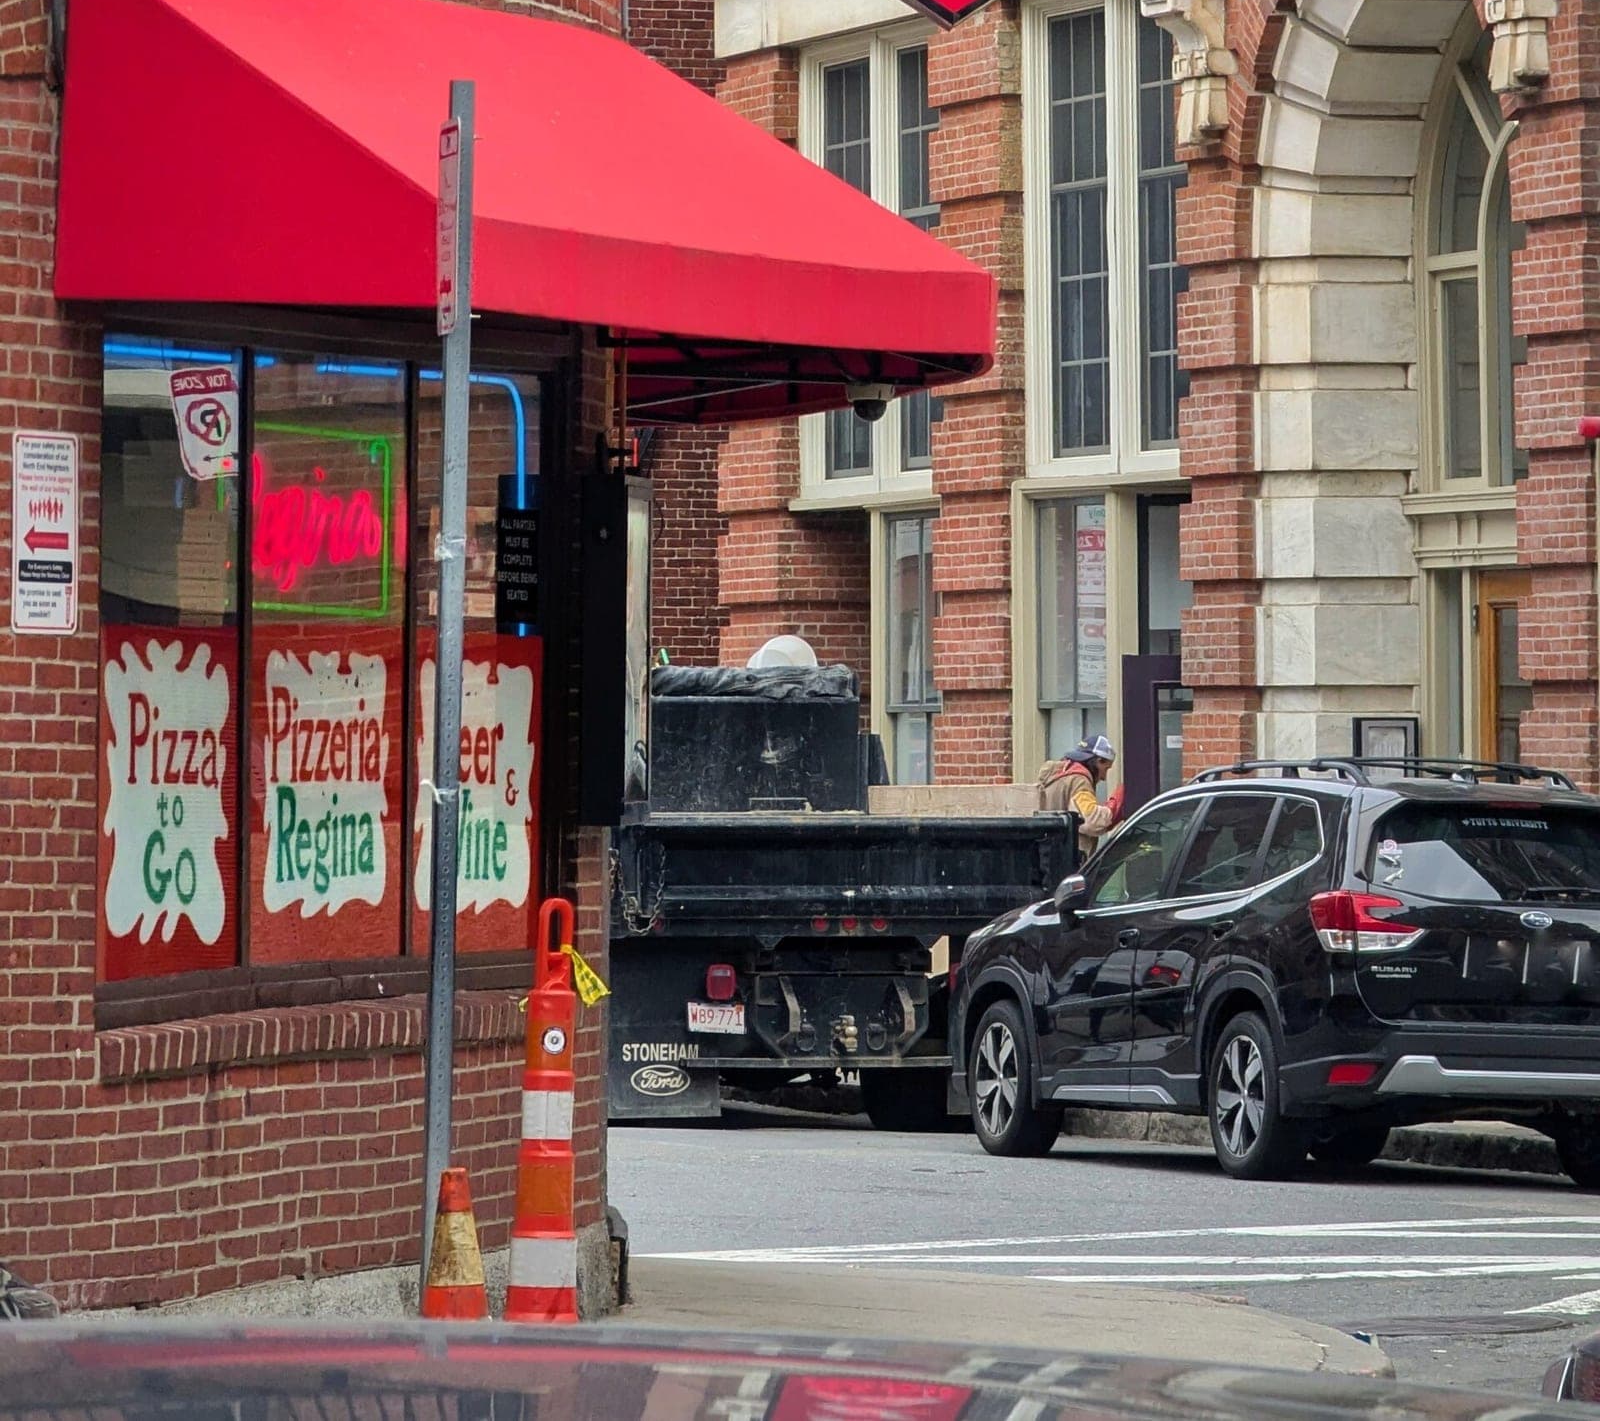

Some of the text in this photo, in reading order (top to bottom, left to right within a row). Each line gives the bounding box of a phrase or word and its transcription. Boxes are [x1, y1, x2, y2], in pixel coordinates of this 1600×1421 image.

[126, 691, 219, 789] Pizza
[269, 685, 382, 784] Pizzeria
[459, 722, 520, 807] eer &
[156, 791, 184, 828] to
[275, 784, 375, 894] Regina
[1370, 965, 1418, 974] SUBARU
[622, 1043, 700, 1062] STONEHAM
[640, 1069, 686, 1089] Ford
